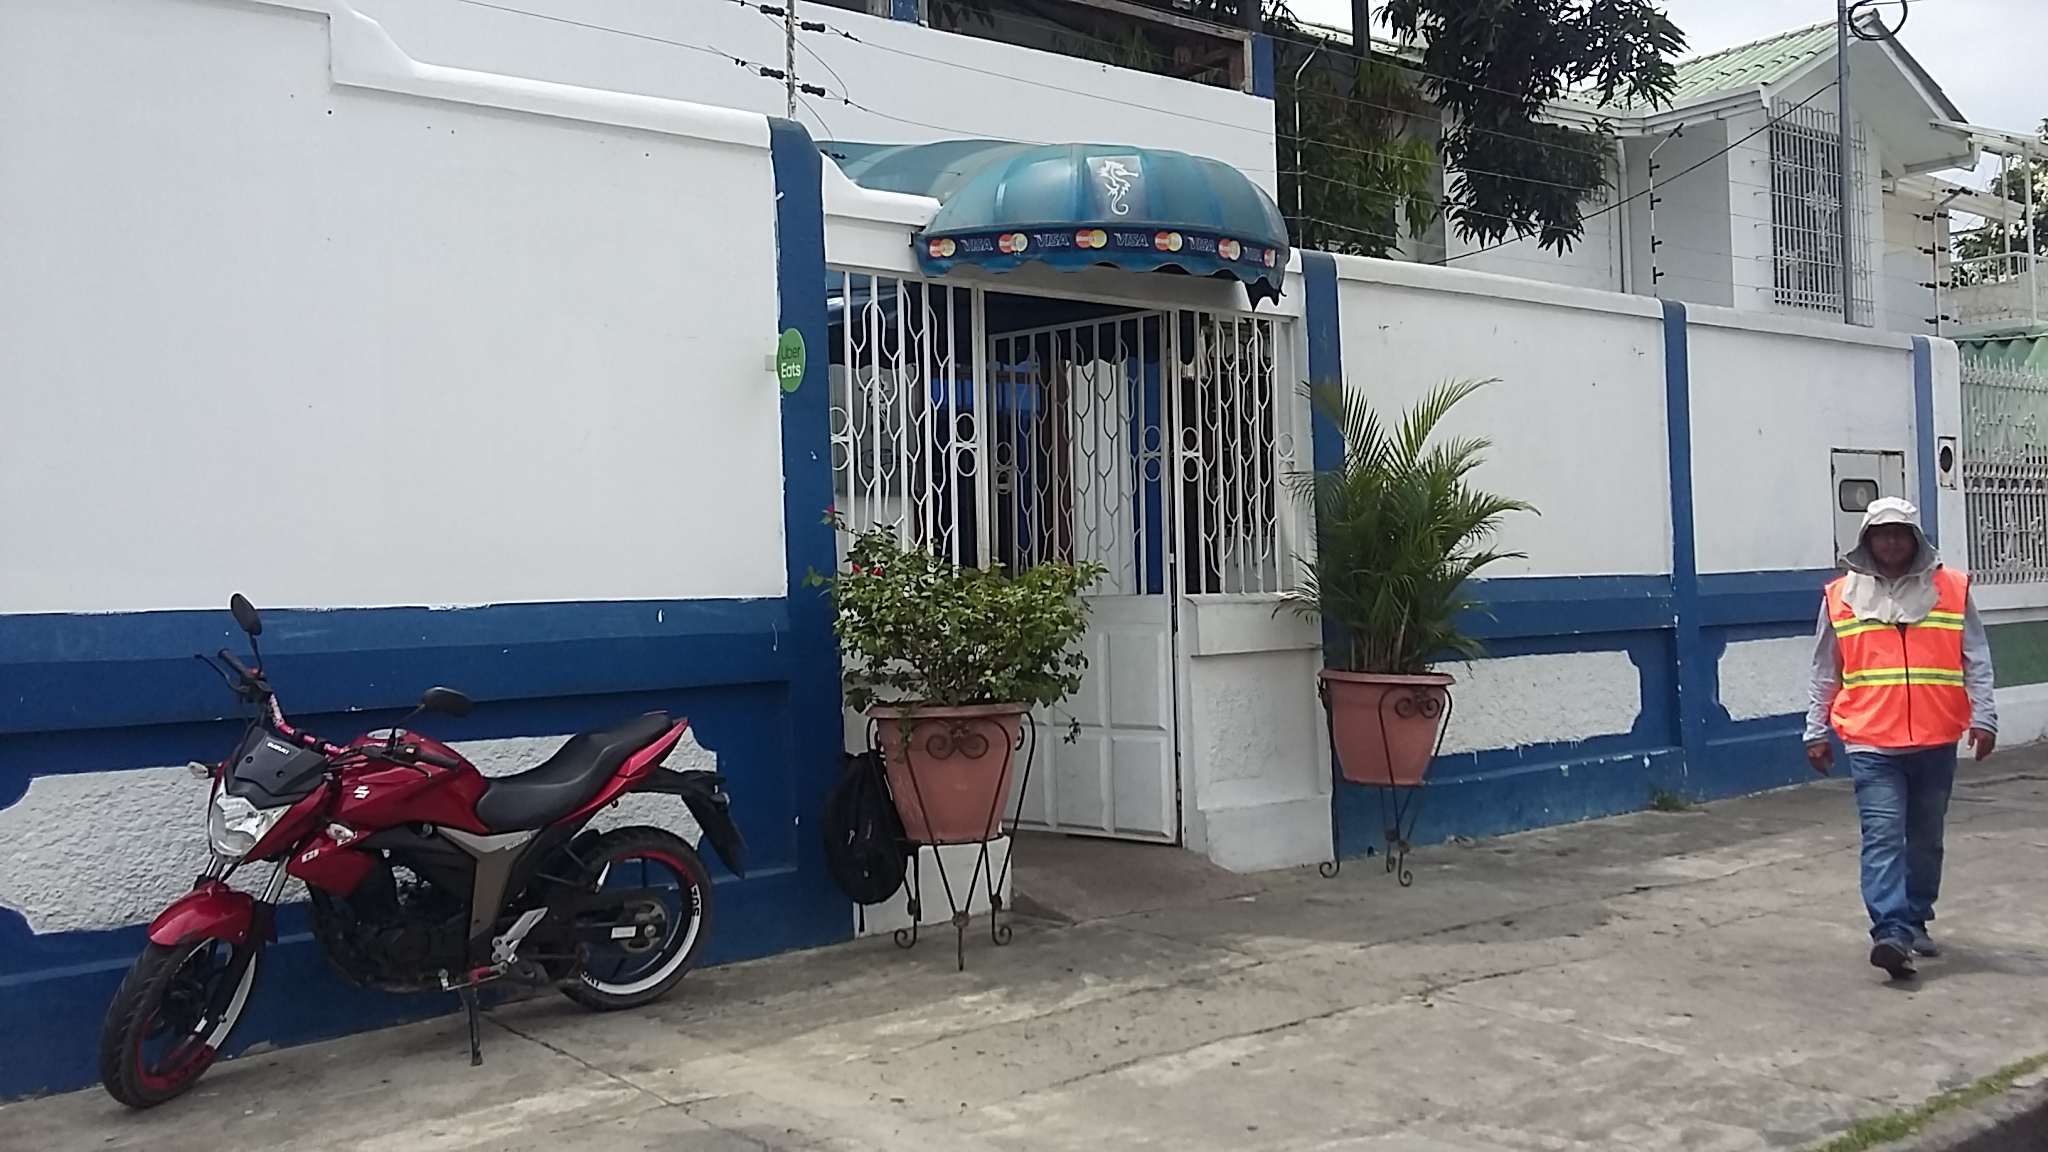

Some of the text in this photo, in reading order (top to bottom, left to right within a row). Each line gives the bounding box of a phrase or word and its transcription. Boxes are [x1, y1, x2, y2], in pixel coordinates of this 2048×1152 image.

[960, 238, 993, 251] VISA
[1034, 233, 1070, 247] VISA
[1114, 233, 1149, 247] VISA
[1187, 236, 1216, 253] VISA
[1243, 246, 1262, 262] VISA
[781, 346, 800, 359] Uber
[781, 362, 801, 378] Eats
[266, 741, 290, 755] SUZUKI
